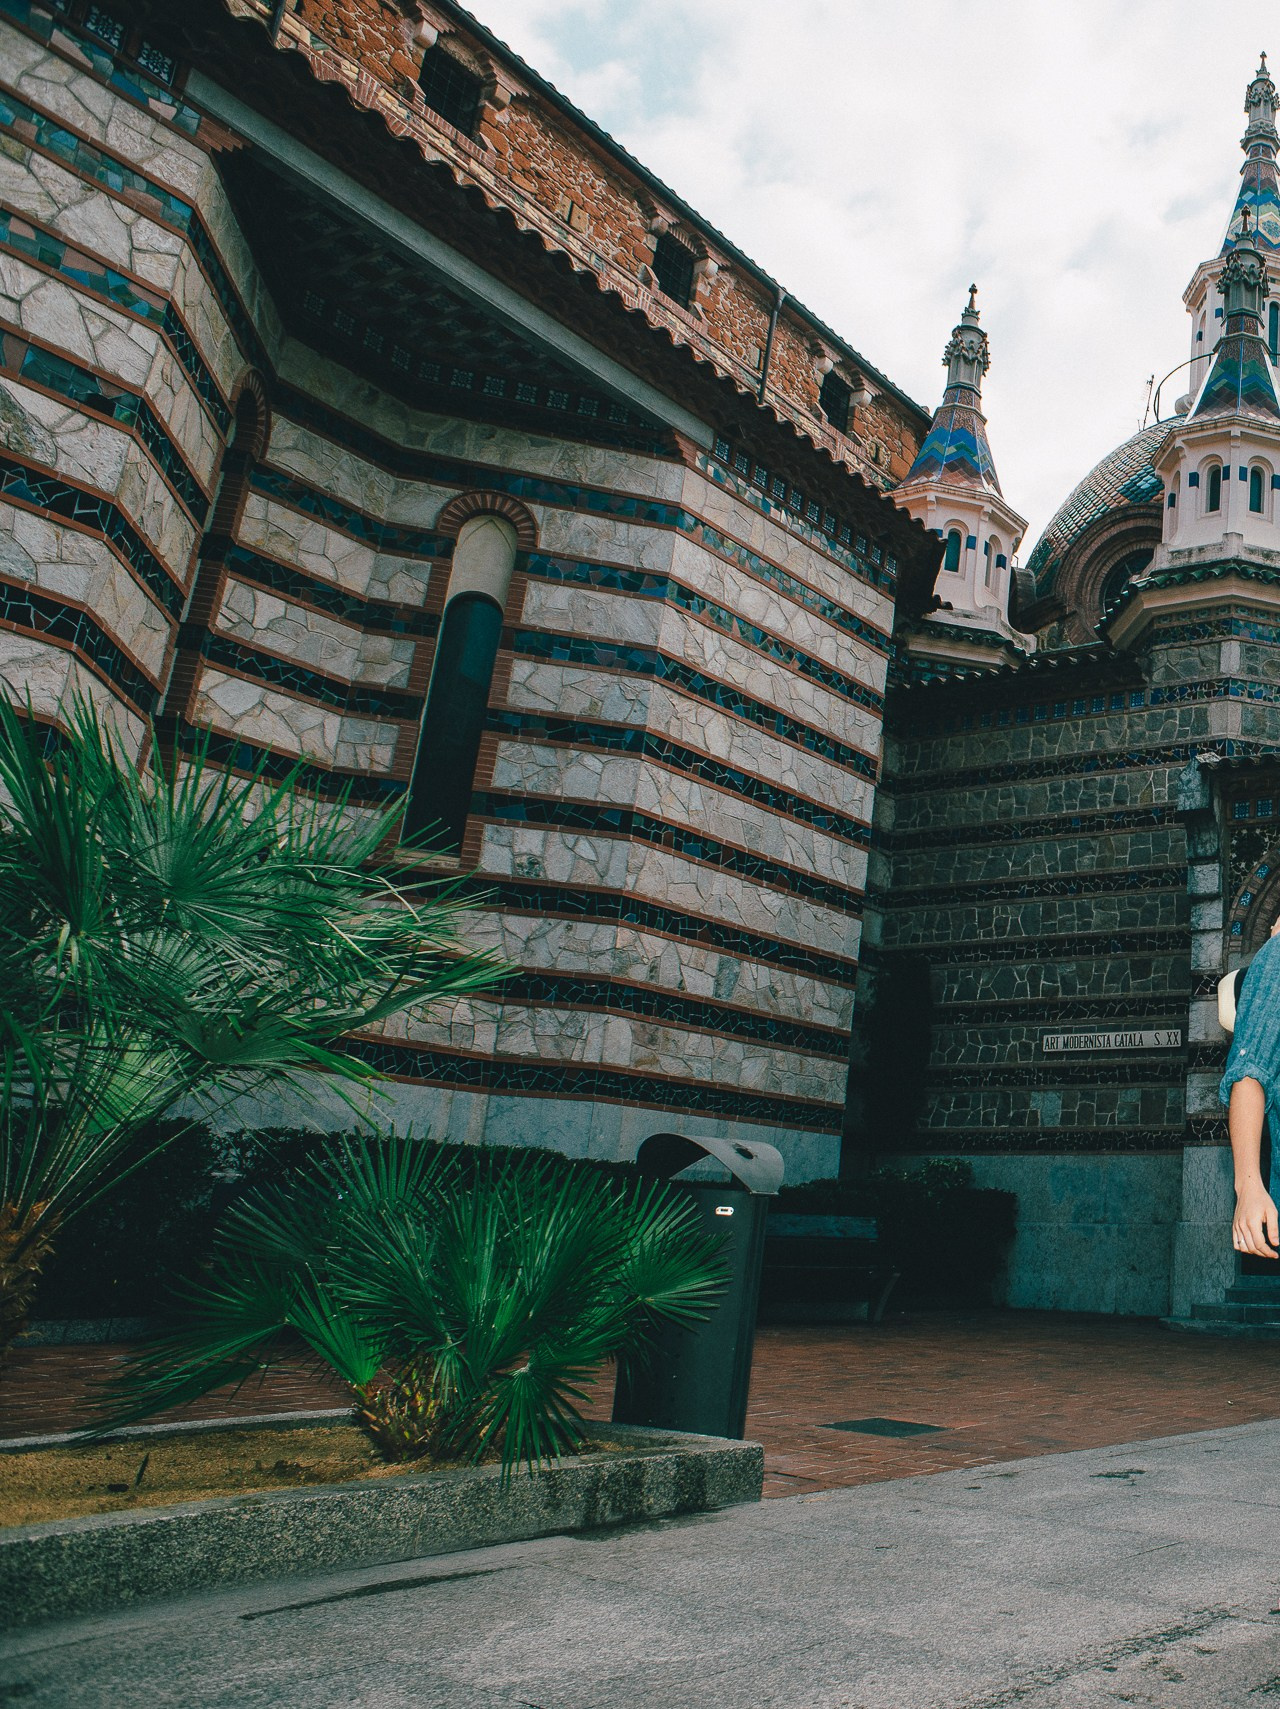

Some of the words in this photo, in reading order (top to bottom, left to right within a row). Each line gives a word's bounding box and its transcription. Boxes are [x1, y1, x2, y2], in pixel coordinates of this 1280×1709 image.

[1044, 1036, 1059, 1050] ART
[1062, 1034, 1111, 1050] MODERNISTA
[1114, 1032, 1144, 1047] CATALÀ
[1154, 1032, 1163, 1046] S.
[1166, 1031, 1180, 1046] XX
